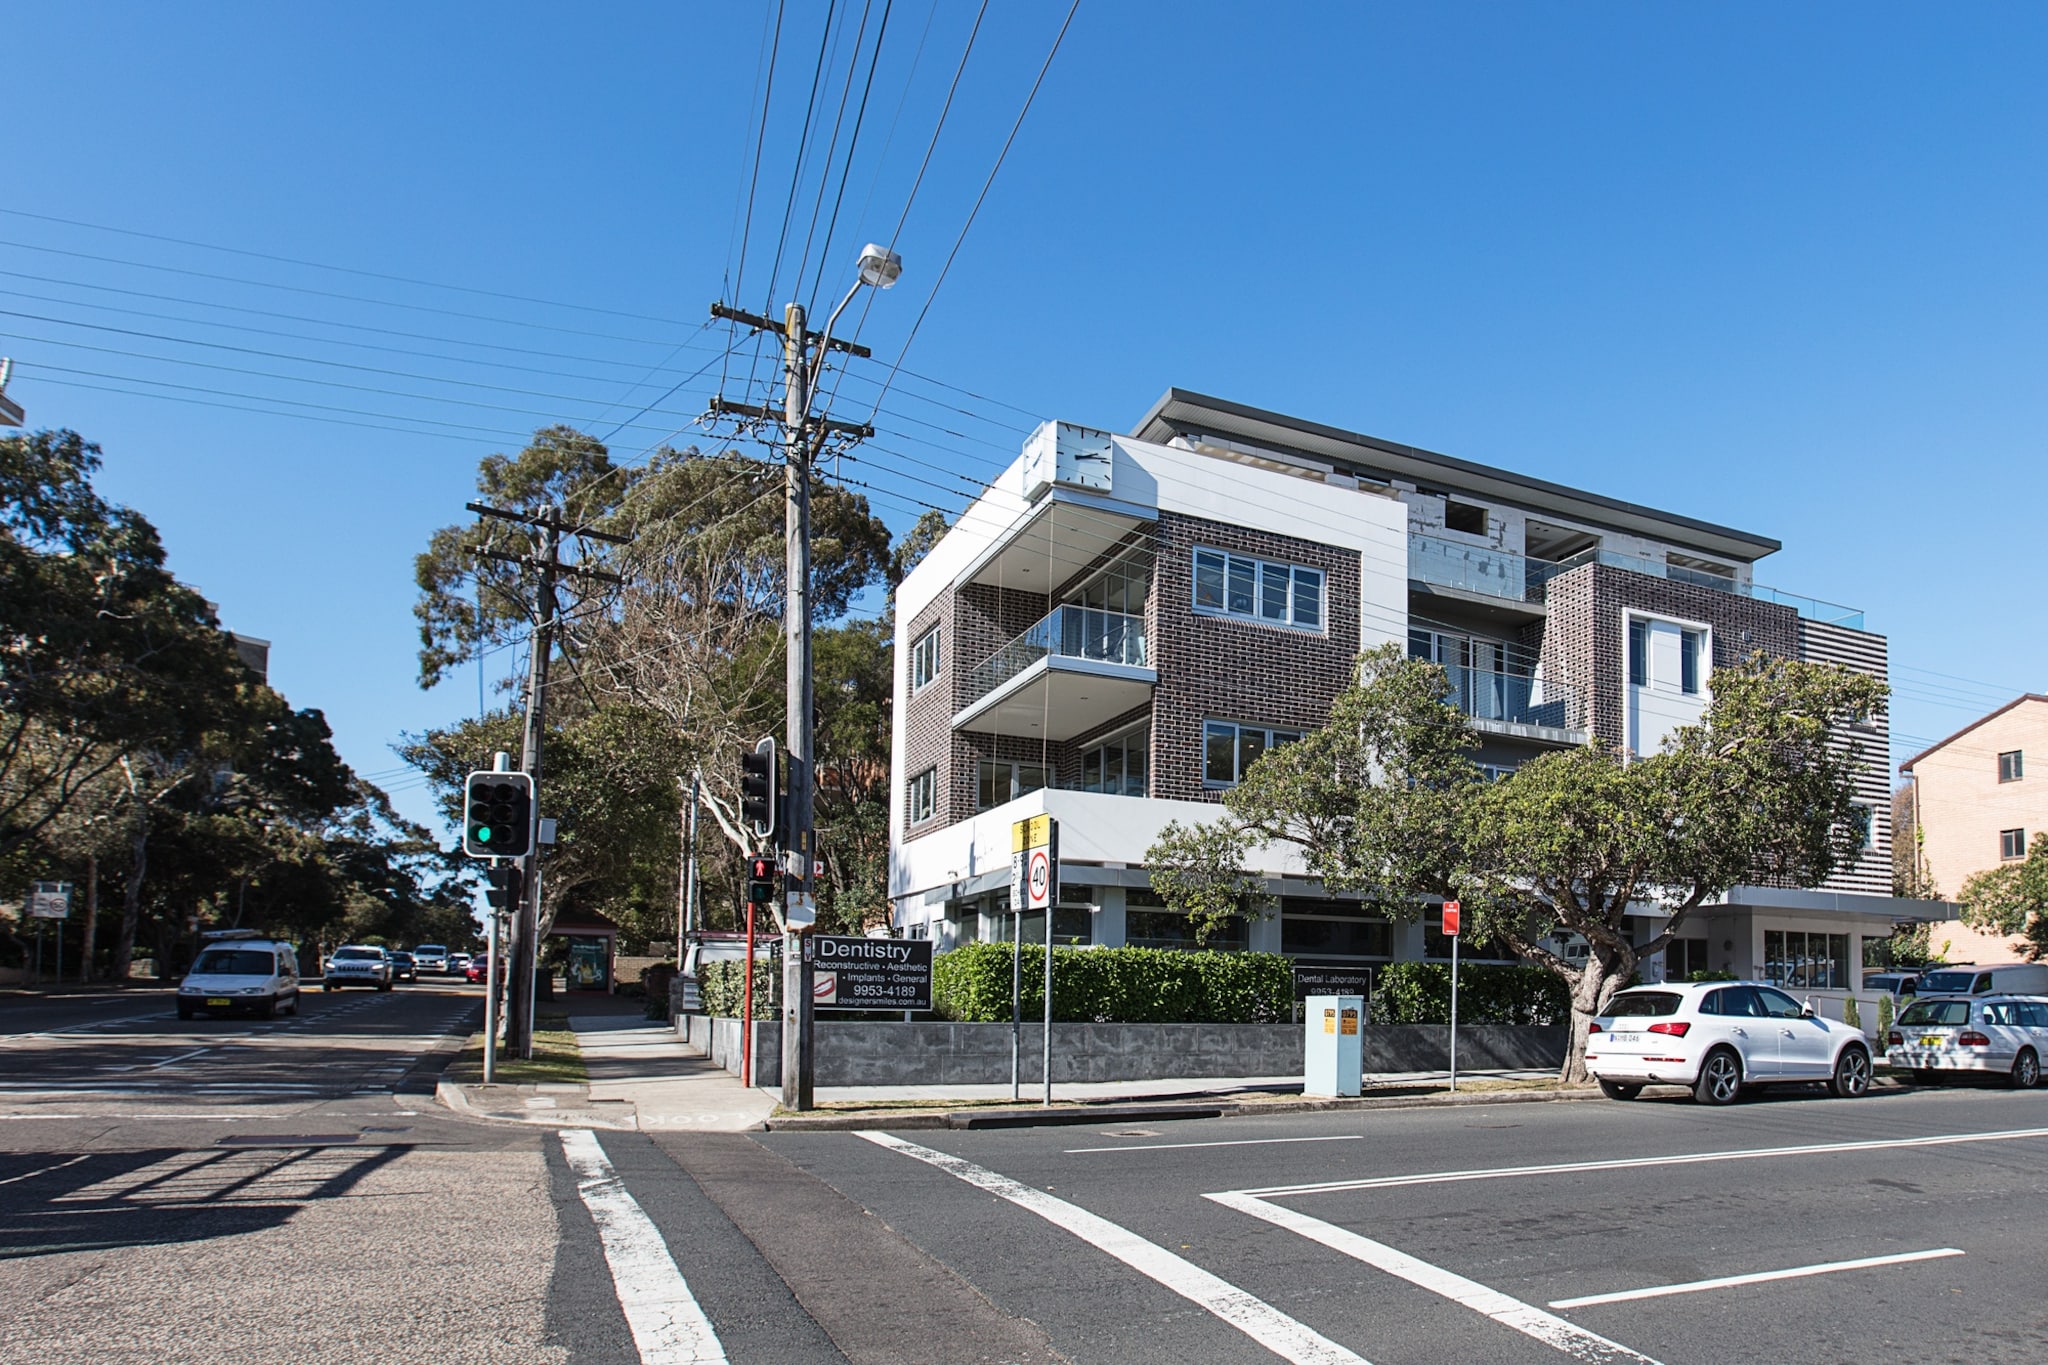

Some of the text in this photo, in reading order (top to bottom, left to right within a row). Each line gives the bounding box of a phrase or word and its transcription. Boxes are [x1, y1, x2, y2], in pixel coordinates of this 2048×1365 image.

[1033, 865, 1046, 888] 40
[821, 940, 912, 962] Dentistry
[814, 960, 928, 972] Reconstructive Aesthetic
[847, 973, 928, 983] Implants General
[1298, 974, 1366, 986] Dental Laboratory
[853, 984, 916, 997] 9953-4189
[838, 997, 927, 1006] designersmiles.com.au
